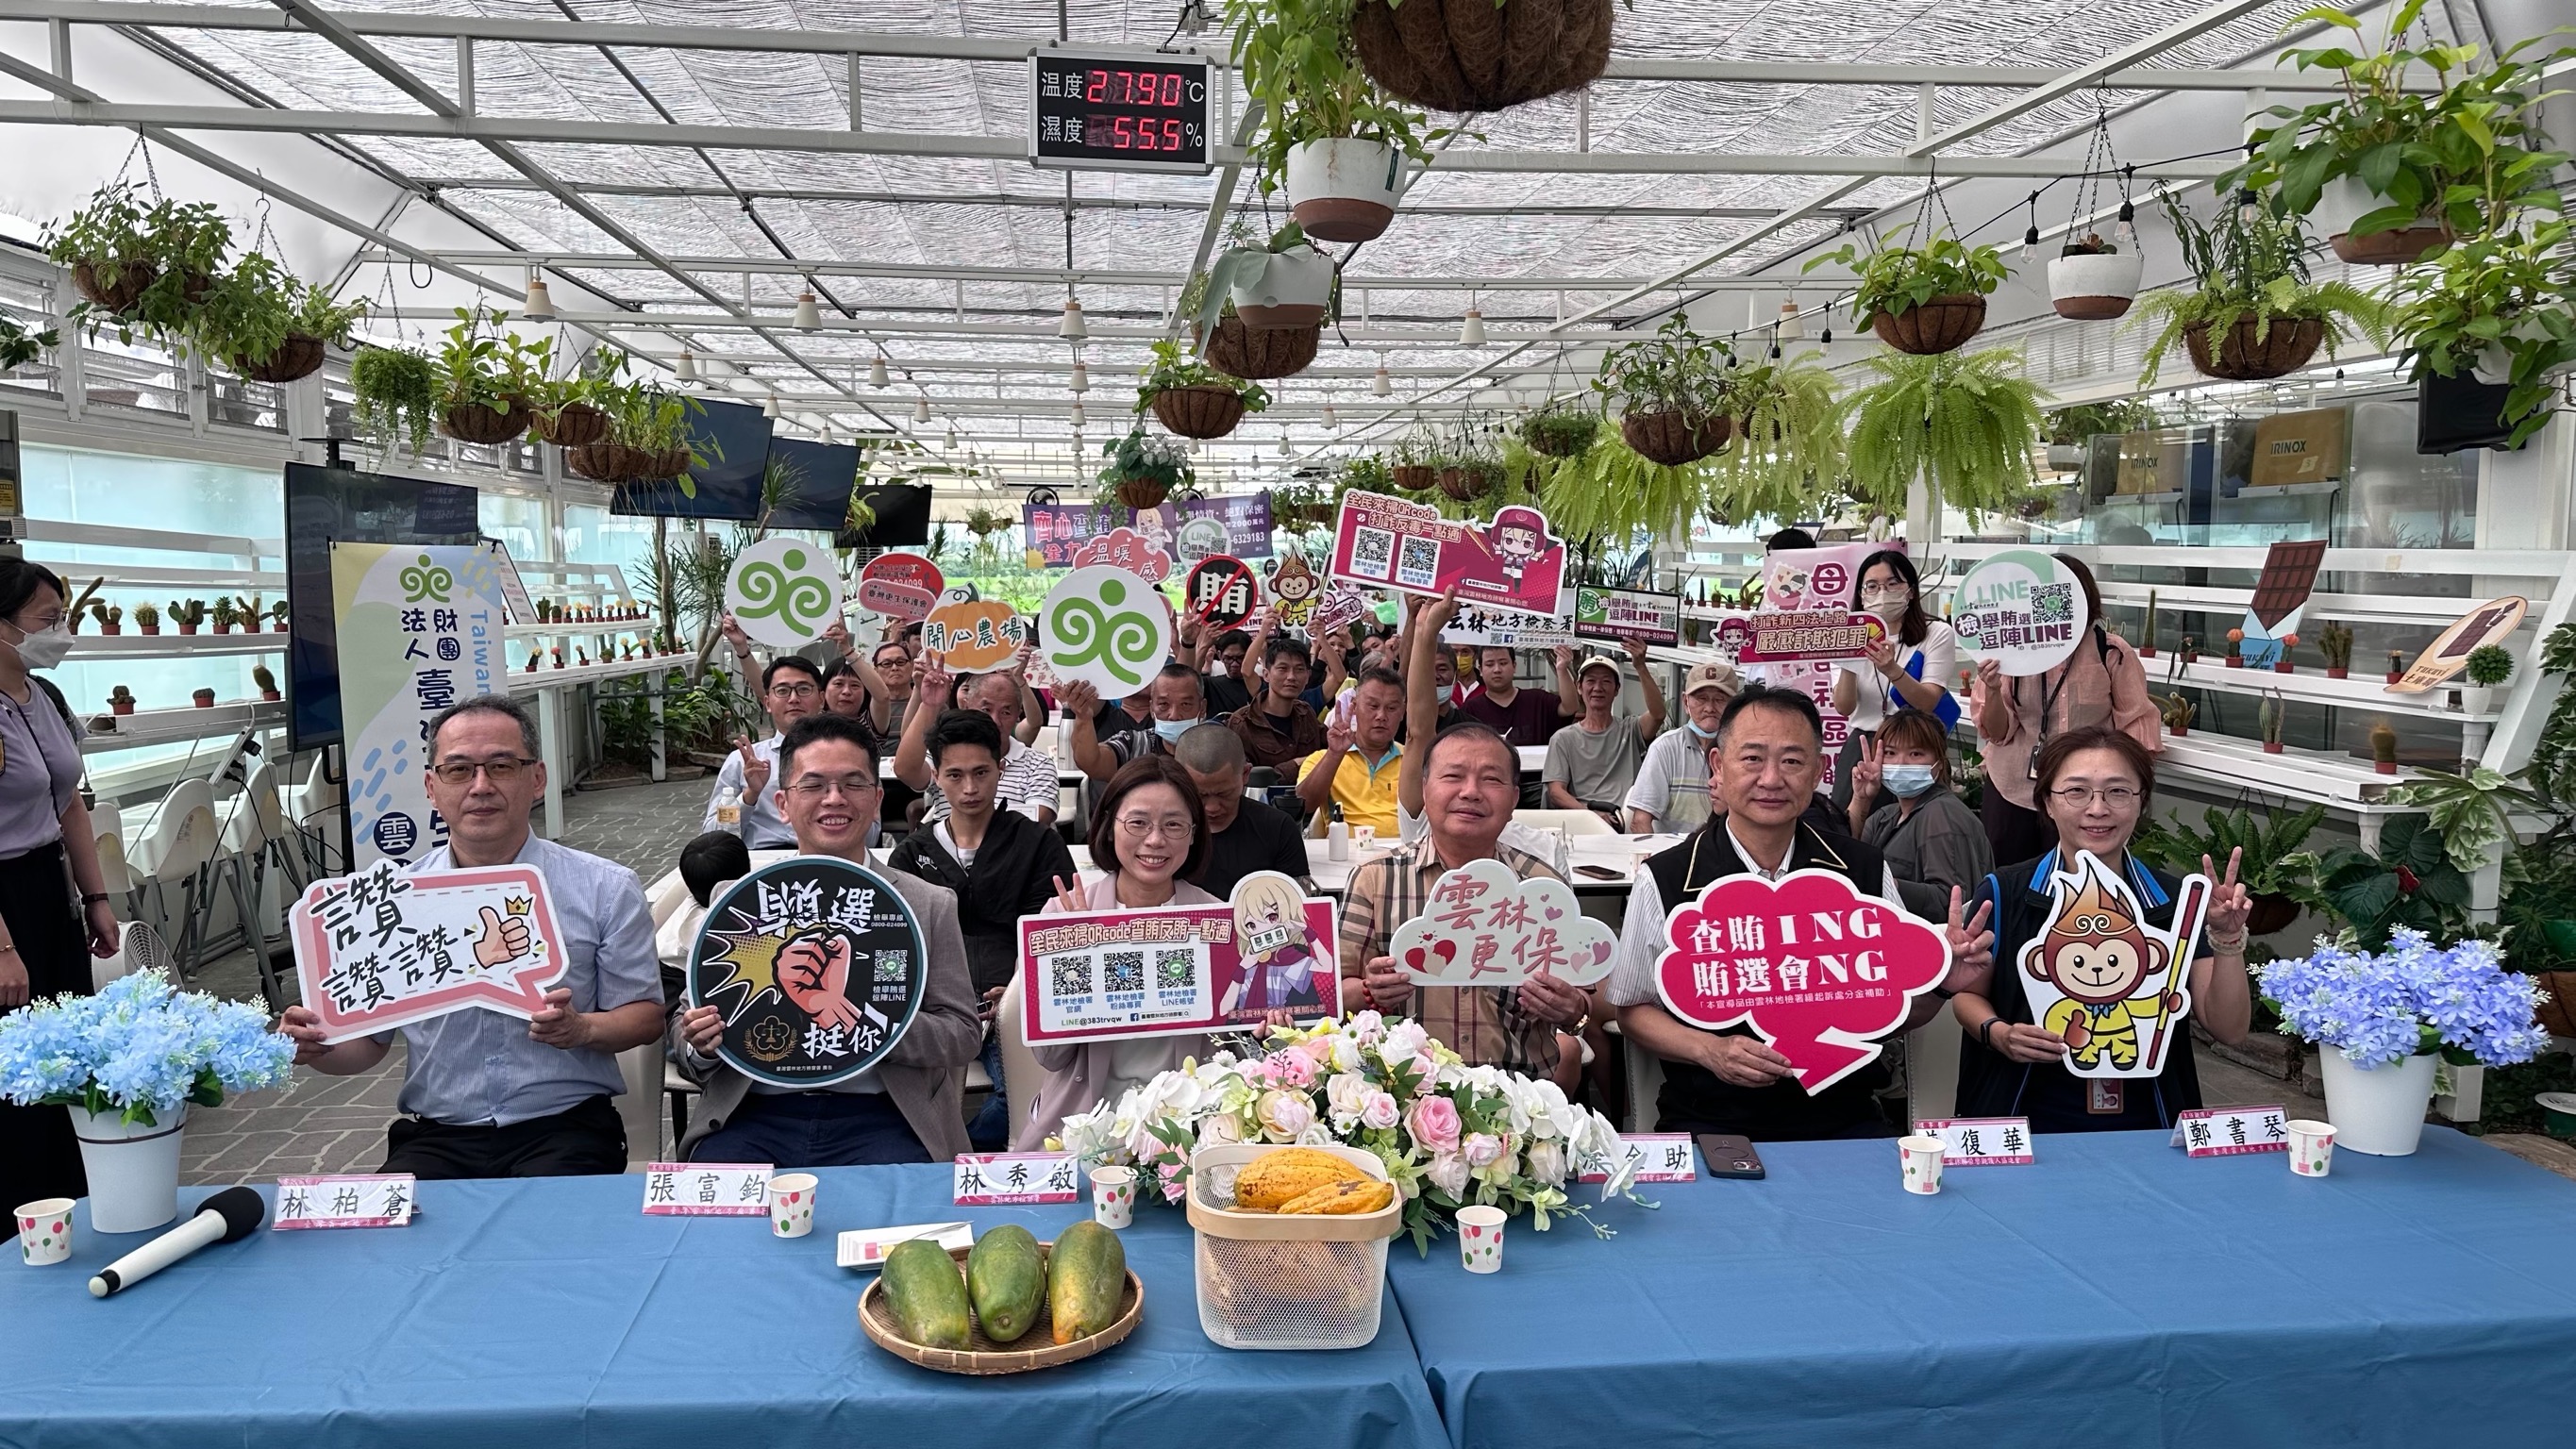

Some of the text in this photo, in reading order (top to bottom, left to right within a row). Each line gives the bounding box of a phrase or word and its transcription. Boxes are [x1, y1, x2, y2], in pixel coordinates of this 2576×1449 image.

[1041, 72, 1082, 99] 溫度
[1087, 71, 1181, 107] 27.90
[1041, 115, 1203, 151] 濕度 55.5 %
[2270, 440, 2307, 455] IRINOX
[2131, 457, 2158, 470] IRINOX
[1347, 493, 1437, 520] 全民來掃QRcode
[1088, 543, 1133, 565] 溫暖
[1198, 571, 1248, 615] 賄
[1811, 562, 1848, 595] 母
[1977, 580, 2029, 604] LINE
[926, 616, 1024, 653] 開心農場
[1751, 610, 1848, 629] 打詐新四法上路
[1956, 610, 2032, 637] 檢舉賄選
[1757, 626, 1866, 652] 嚴懲詐欺犯罪
[1979, 623, 2073, 651] 逗陣LINE
[1705, 667, 1716, 679] C
[311, 863, 418, 951] 讚
[1434, 874, 1538, 934] 雲林
[1029, 919, 1231, 956] 全民來掃QRcode查賄反賄一點通
[1686, 915, 1766, 956] 查賄
[1469, 925, 1569, 979] 更保
[1693, 949, 1888, 998] 賄選會NG
[1053, 989, 1197, 1007] 雲林地檢署 雲林地檢署 雲林地檢署
[1065, 997, 1195, 1013] 官網 粉絲專頁 LINE帳號
[1926, 1126, 2024, 1156] 復華
[2190, 1115, 2285, 1146] 鄭書琴
[2213, 1144, 2288, 1156] 臺灣雲林地方檢察
[650, 1173, 766, 1205] 張富鈞
[960, 1162, 1076, 1195] 林秀敏
[282, 1184, 410, 1219] 林柏蒼
